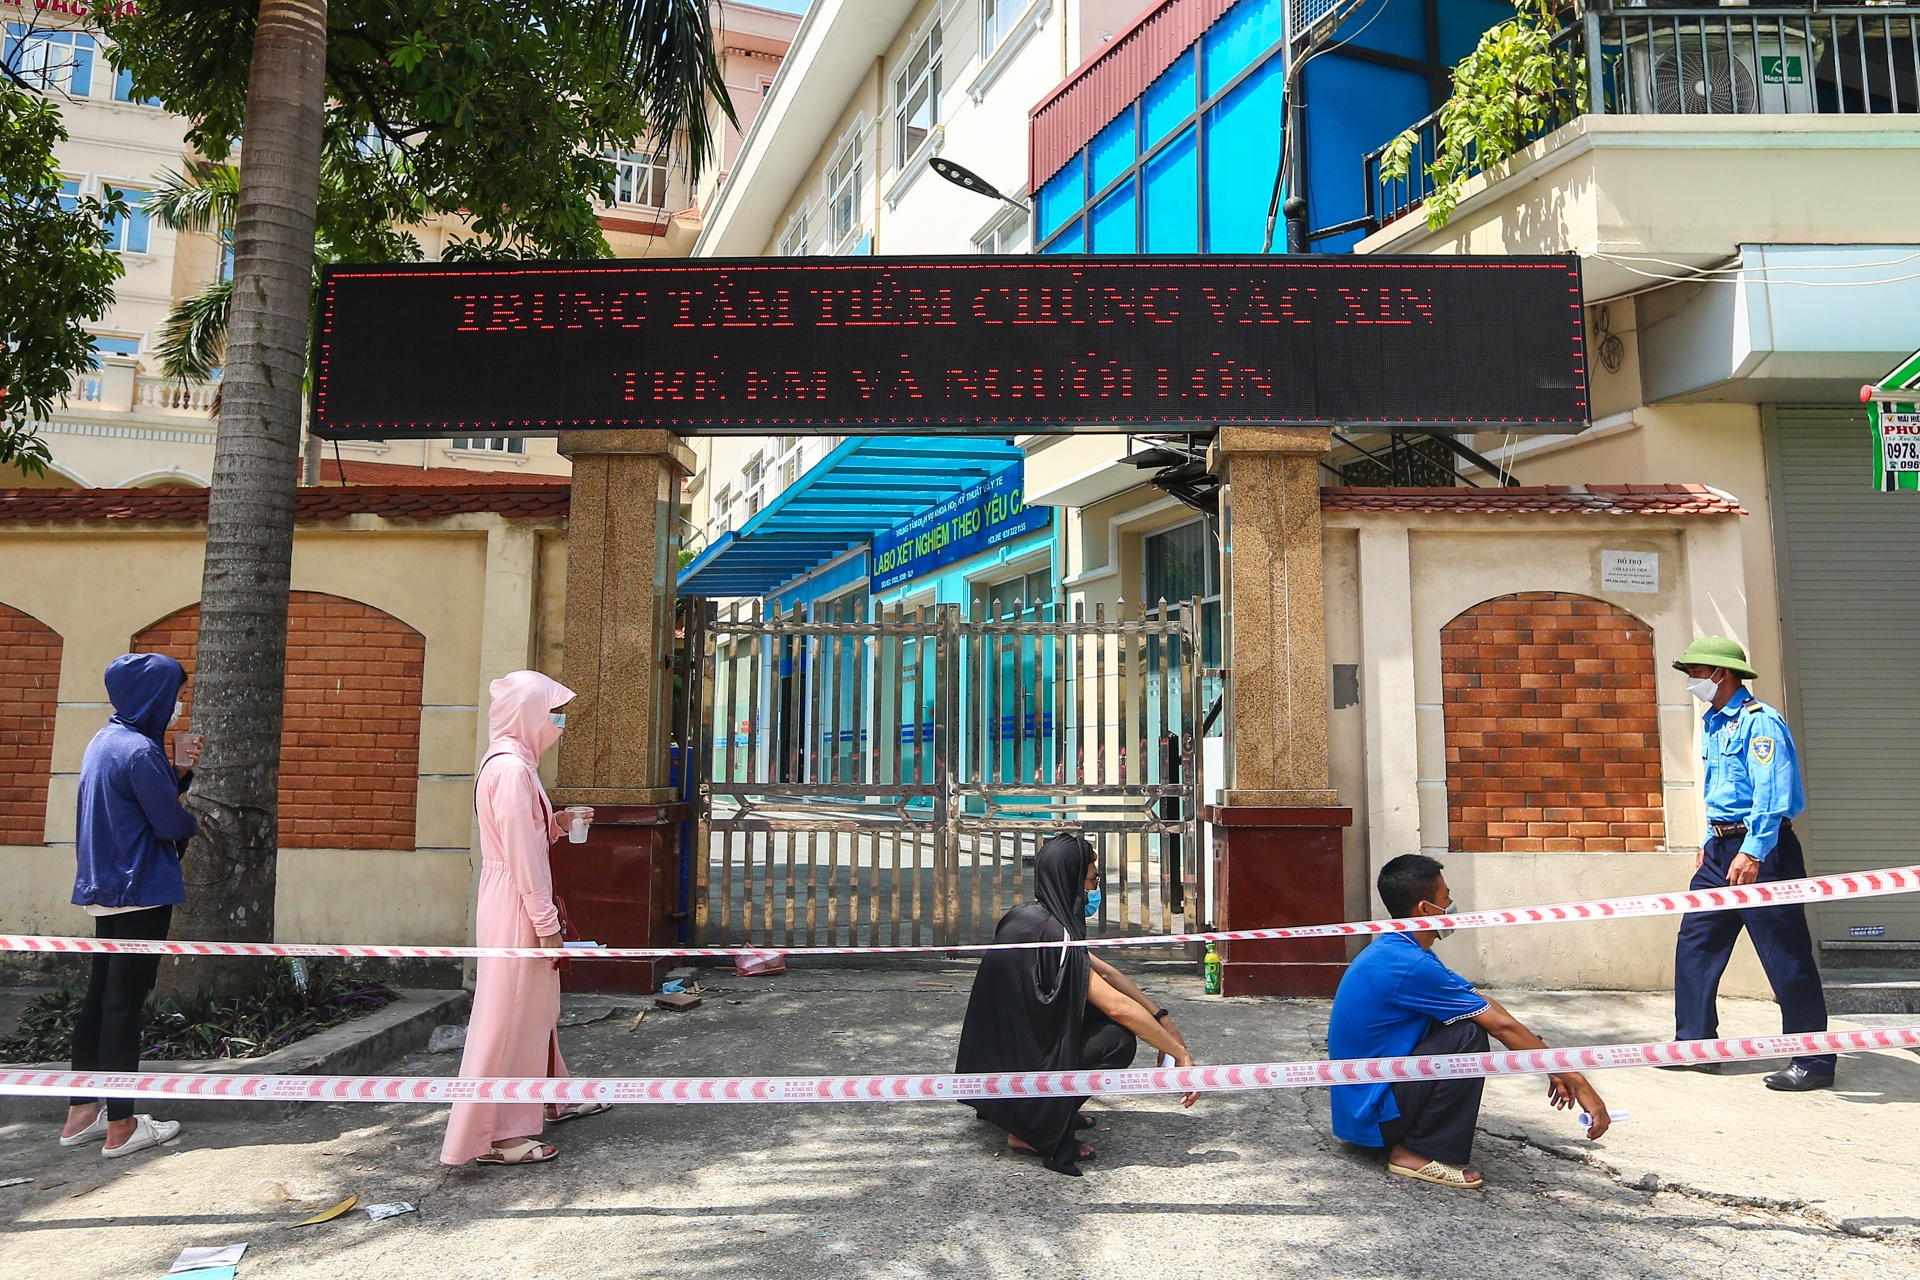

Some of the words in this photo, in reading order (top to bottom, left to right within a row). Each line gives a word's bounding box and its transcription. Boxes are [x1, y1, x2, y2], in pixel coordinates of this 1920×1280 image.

[454, 292, 648, 331] TRUNG
[667, 275, 795, 328] TÂM
[809, 274, 958, 326] TIÊM
[1334, 287, 1434, 326] XIN
[873, 549, 896, 577] LABO
[896, 537, 914, 567] XÉT
[915, 522, 950, 558] NGHIỆM
[951, 508, 981, 541] THEO
[983, 493, 1008, 527] YÊU
